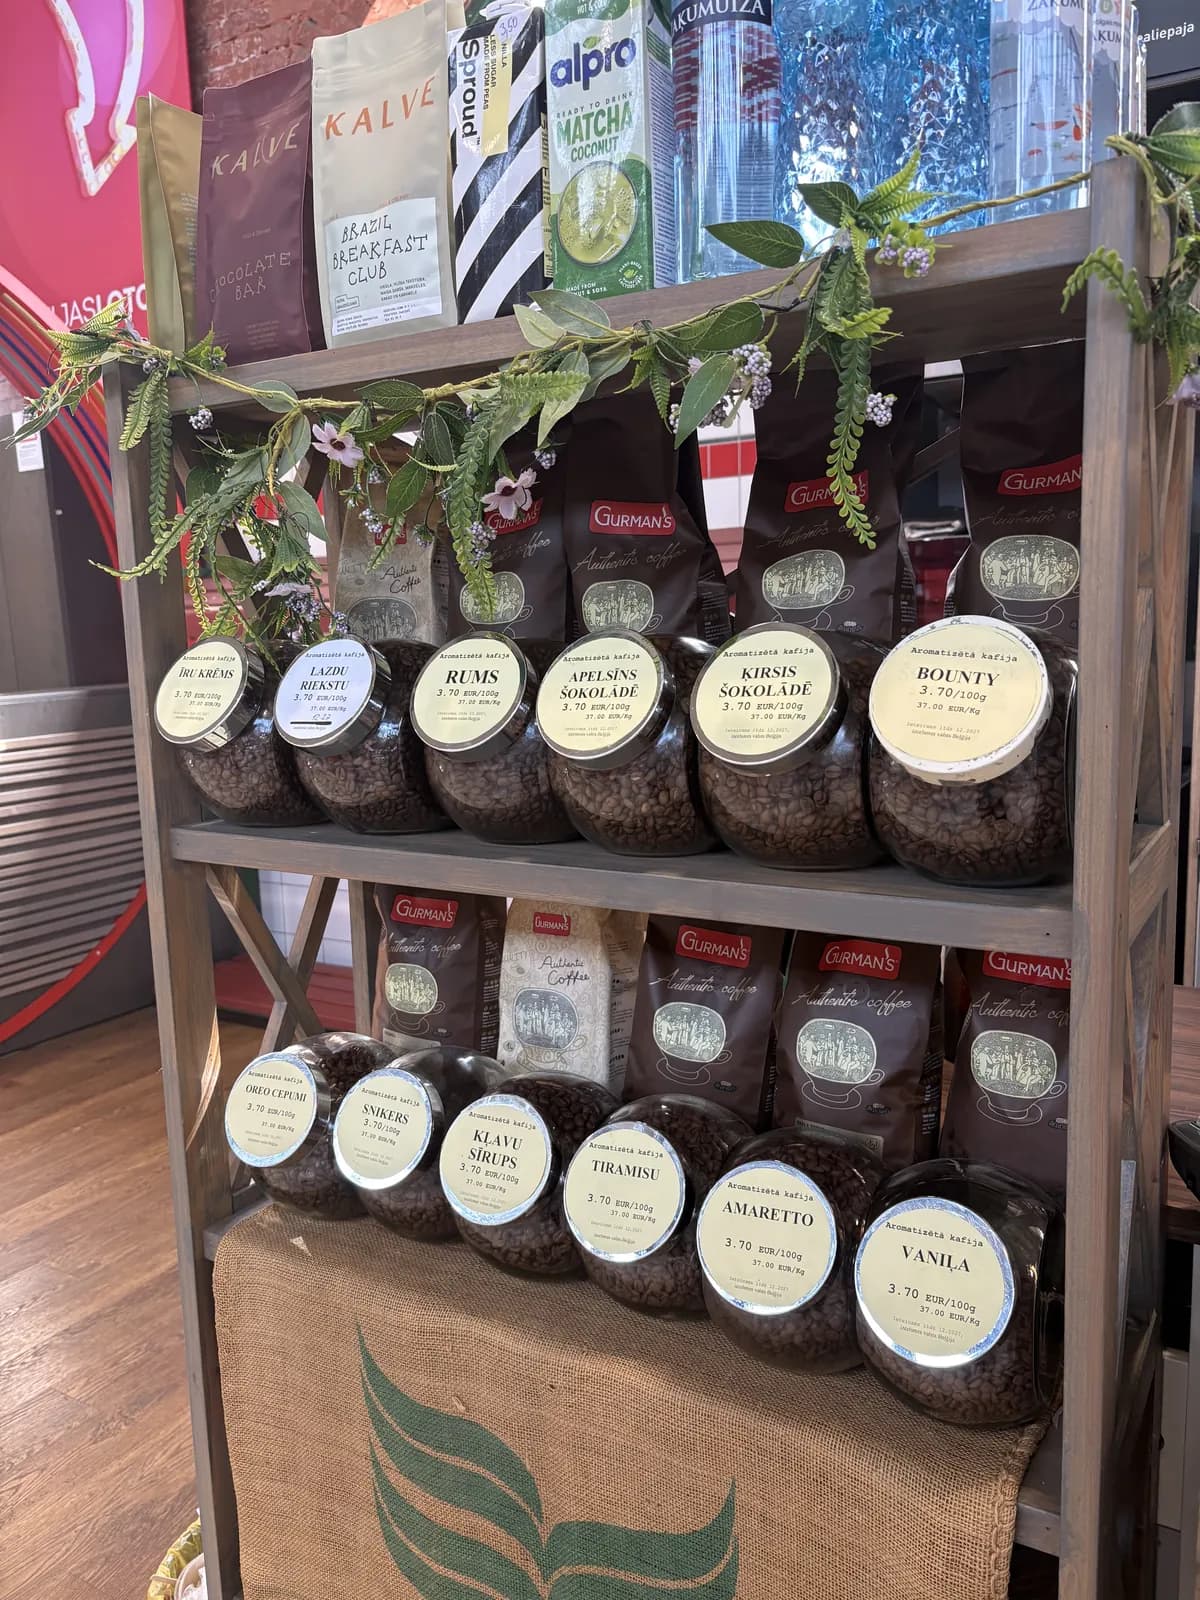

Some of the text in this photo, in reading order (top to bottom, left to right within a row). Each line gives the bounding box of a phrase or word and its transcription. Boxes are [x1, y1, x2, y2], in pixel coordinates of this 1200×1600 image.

[550, 37, 637, 91] alpro
[324, 74, 436, 140] KALVE
[556, 91, 633, 118] READY TO DRINK
[556, 101, 633, 148] MATCHA
[211, 122, 300, 178] KALVE
[571, 137, 619, 162] COCONUT
[341, 214, 392, 244] BRAZIL
[333, 234, 428, 270] BREAKFAST
[348, 261, 387, 286] CLUB
[235, 276, 266, 301] BAR
[594, 505, 672, 529] GURMAN'S
[783, 647, 814, 655] kafija
[981, 652, 1018, 663] kafija
[199, 667, 235, 679] KRĒMS
[310, 666, 349, 676] LAZDU
[445, 669, 499, 684] RUMS
[569, 668, 638, 682] APELSĪNS
[741, 665, 797, 682] ĶIRSIS
[916, 666, 1000, 686] BOUNTY
[300, 680, 350, 690] RIEKSTU
[437, 689, 499, 698] 3.70 EUR/100g
[560, 684, 639, 699] ŠOKOLĀDĒ
[719, 681, 812, 698] ŠOKOLĀDĒ
[919, 685, 987, 702] 3.70/100g
[562, 703, 586, 711] 3.70
[722, 702, 803, 711] 3.70 EUR/100g
[917, 701, 981, 716] 37.00 EUR/Kg
[396, 900, 456, 923] GURMAN'S
[535, 912, 569, 931] GURMAN'S
[681, 929, 748, 960] GURMAN'S
[538, 956, 585, 970] Authentic
[825, 945, 895, 972] GURMAN'S
[548, 970, 590, 986] Coffee
[867, 990, 913, 1015] coffee
[246, 1084, 307, 1102] OREO CEPUMI
[247, 1103, 265, 1112] 3.70
[362, 1103, 409, 1125] SNIKERS
[364, 1118, 401, 1136] 3.70/100g
[473, 1129, 523, 1151] KĻAVU
[468, 1147, 518, 1170] SĪRUPS
[460, 1163, 519, 1184] 3.70 EUR/100g
[592, 1159, 660, 1181] TIRAMISU
[587, 1193, 654, 1213] 3.70 EUR/100g
[784, 1190, 814, 1202] kafija
[610, 1210, 629, 1218] 37.00
[722, 1200, 814, 1227] AMARETTO
[725, 1238, 803, 1262] 3.70 EUR/100g
[950, 1233, 984, 1247] kafija
[752, 1259, 805, 1276] 37.00 EUR/Kg
[902, 1245, 970, 1273] VANIĻA
[888, 1283, 977, 1314] 3.70 EUR/100g
[919, 1305, 981, 1327] 37.00 EUR/Kg
